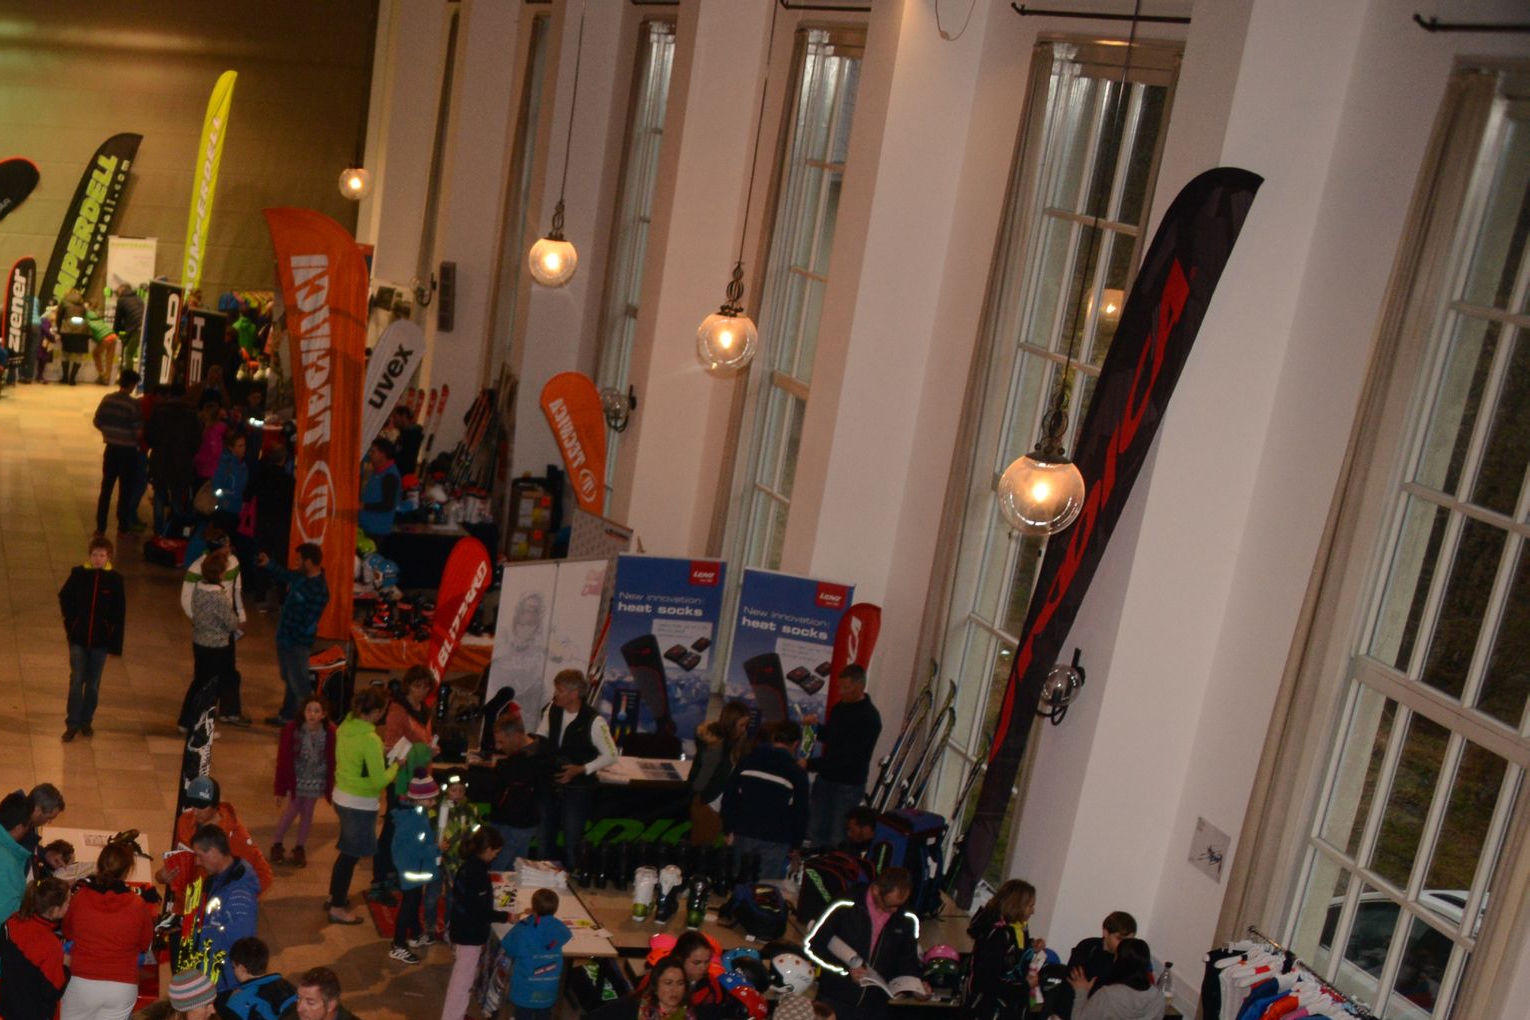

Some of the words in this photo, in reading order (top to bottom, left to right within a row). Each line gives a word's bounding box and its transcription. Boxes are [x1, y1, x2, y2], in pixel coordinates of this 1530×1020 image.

[8, 268, 27, 352] ziener
[369, 344, 415, 409] uvex
[618, 592, 644, 600] New
[617, 601, 652, 613] heat
[657, 605, 703, 617] socks
[743, 606, 768, 617] New
[741, 616, 777, 631] heat
[781, 625, 828, 640] socks
